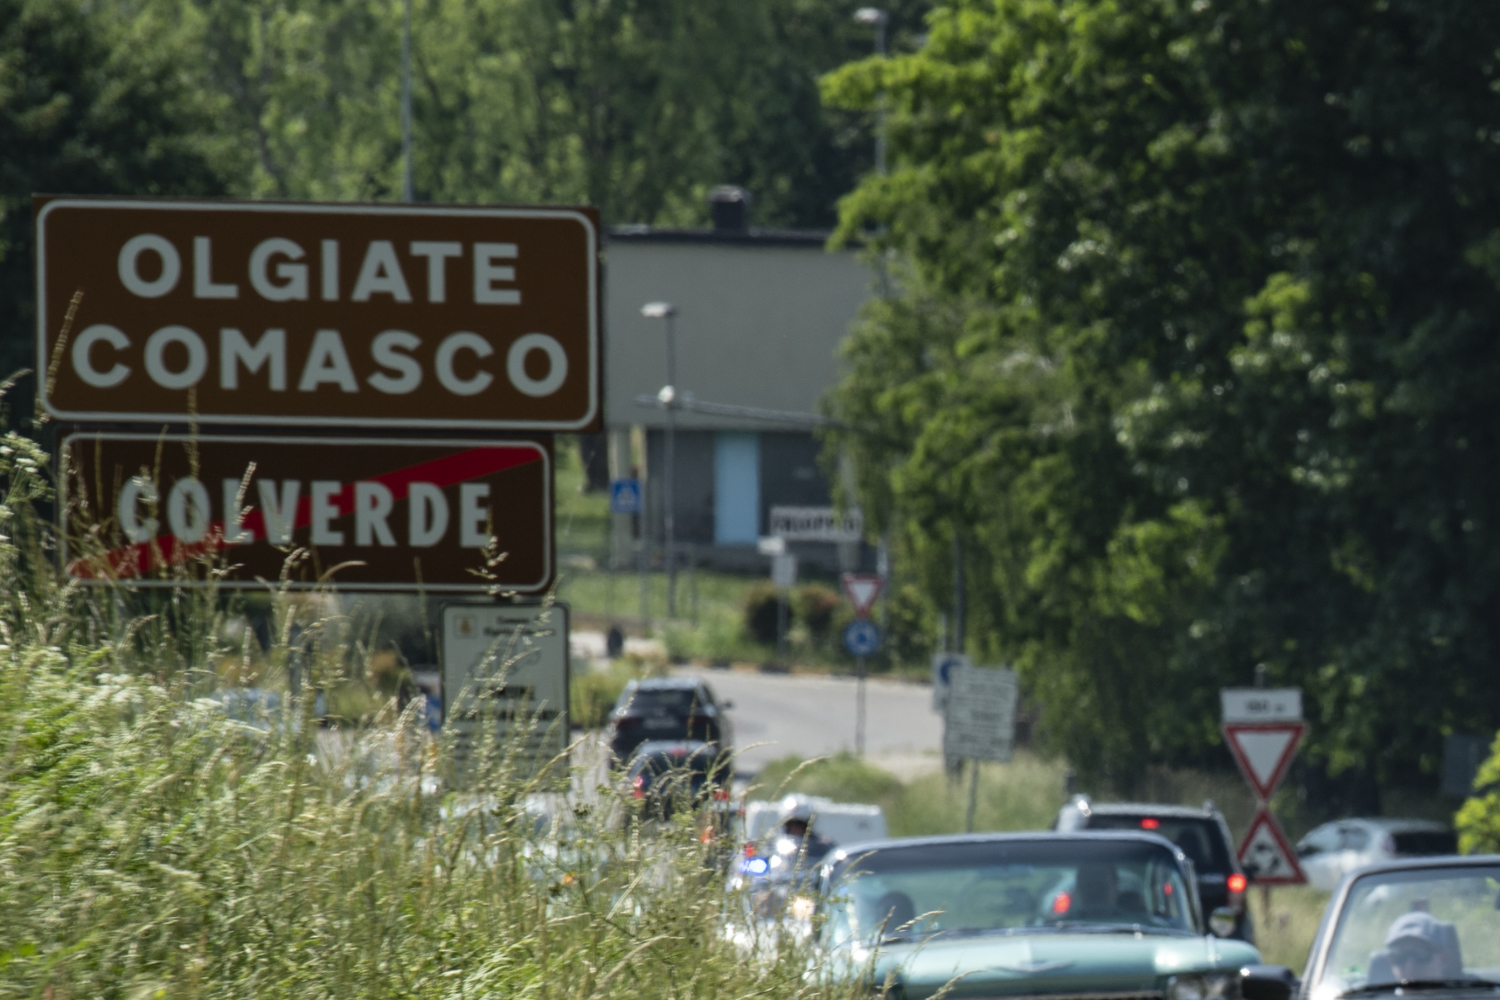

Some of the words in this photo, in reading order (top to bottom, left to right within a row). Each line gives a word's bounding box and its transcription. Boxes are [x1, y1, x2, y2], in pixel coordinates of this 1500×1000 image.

[118, 233, 521, 305] OLGIATE
[71, 324, 569, 397] COMASCO
[118, 477, 491, 548] COLVERDE
